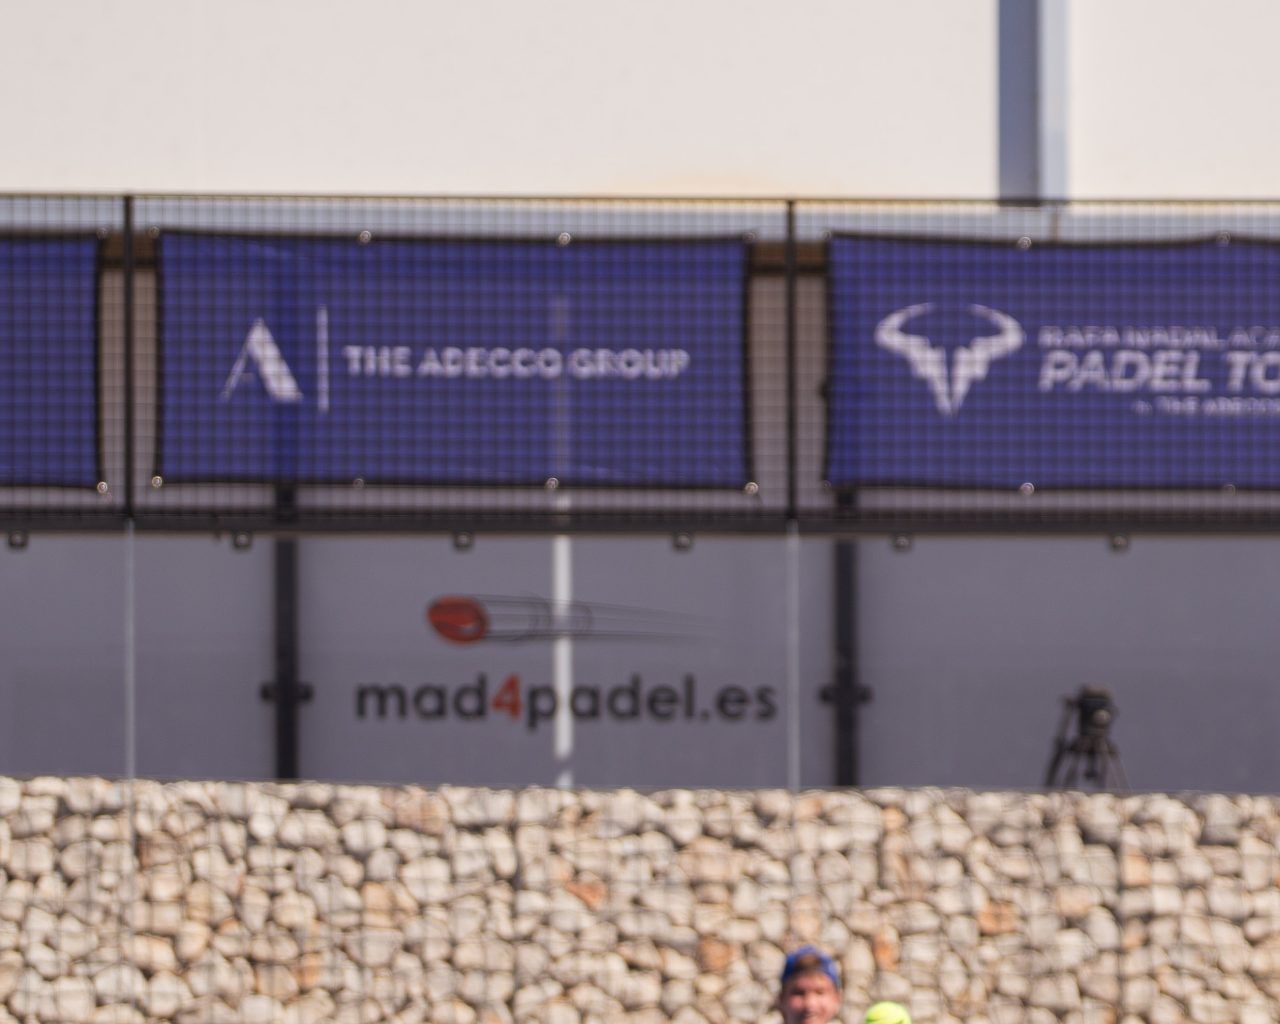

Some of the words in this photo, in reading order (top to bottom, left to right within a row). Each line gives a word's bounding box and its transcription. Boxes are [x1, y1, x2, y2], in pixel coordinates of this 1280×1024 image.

[343, 345, 413, 378] THE
[417, 347, 563, 379] ADECCO
[566, 348, 690, 379] GROUP
[1037, 350, 1213, 393] PADEL
[354, 673, 777, 731] mad4padel.es
